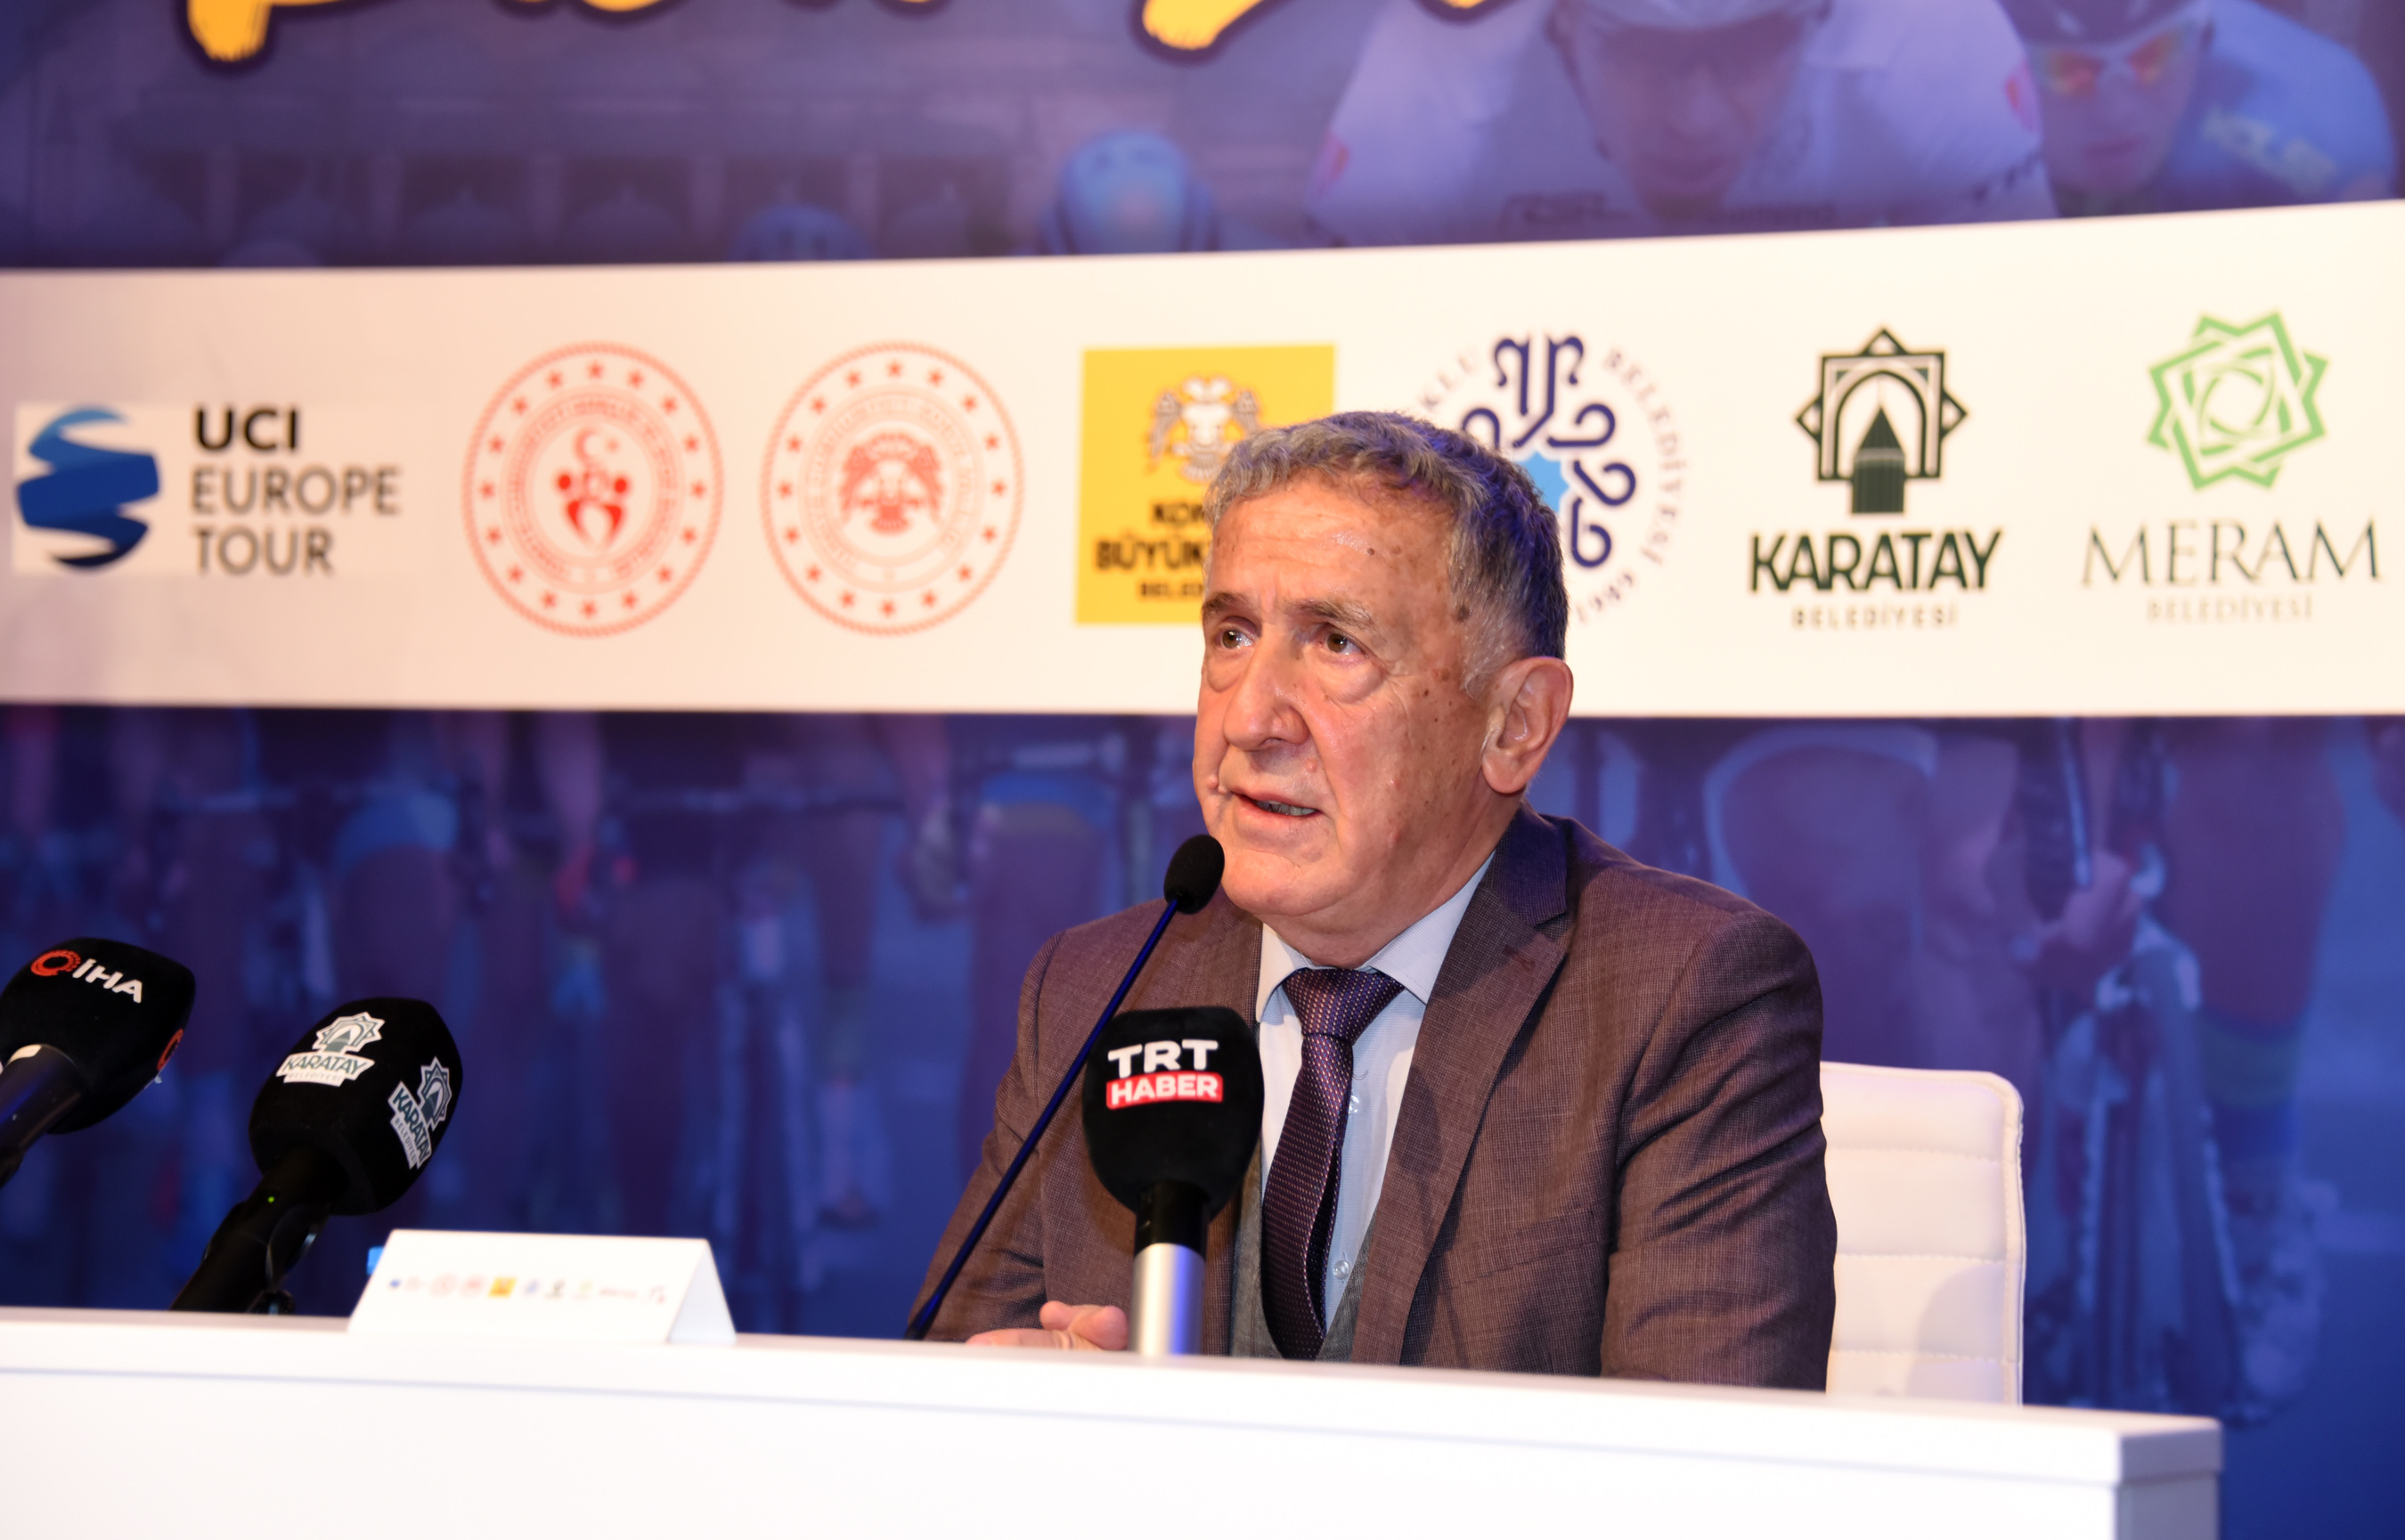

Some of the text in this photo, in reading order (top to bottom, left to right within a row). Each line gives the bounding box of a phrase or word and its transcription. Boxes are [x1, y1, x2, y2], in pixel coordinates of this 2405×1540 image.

[192, 407, 299, 453] UCI
[191, 464, 404, 517] EUROPE
[1154, 502, 1204, 527] KON
[193, 526, 335, 577] TOUR
[1096, 534, 1210, 570] BÜYÜK
[1749, 529, 2002, 593] KARATAY
[2080, 519, 2384, 589] MERAM
[71, 957, 143, 1004] İHA
[282, 1055, 367, 1075] KARATAY
[1107, 1039, 1219, 1079] TRT
[1111, 1074, 1219, 1105] HABER
[392, 1087, 431, 1164] KARATAY
